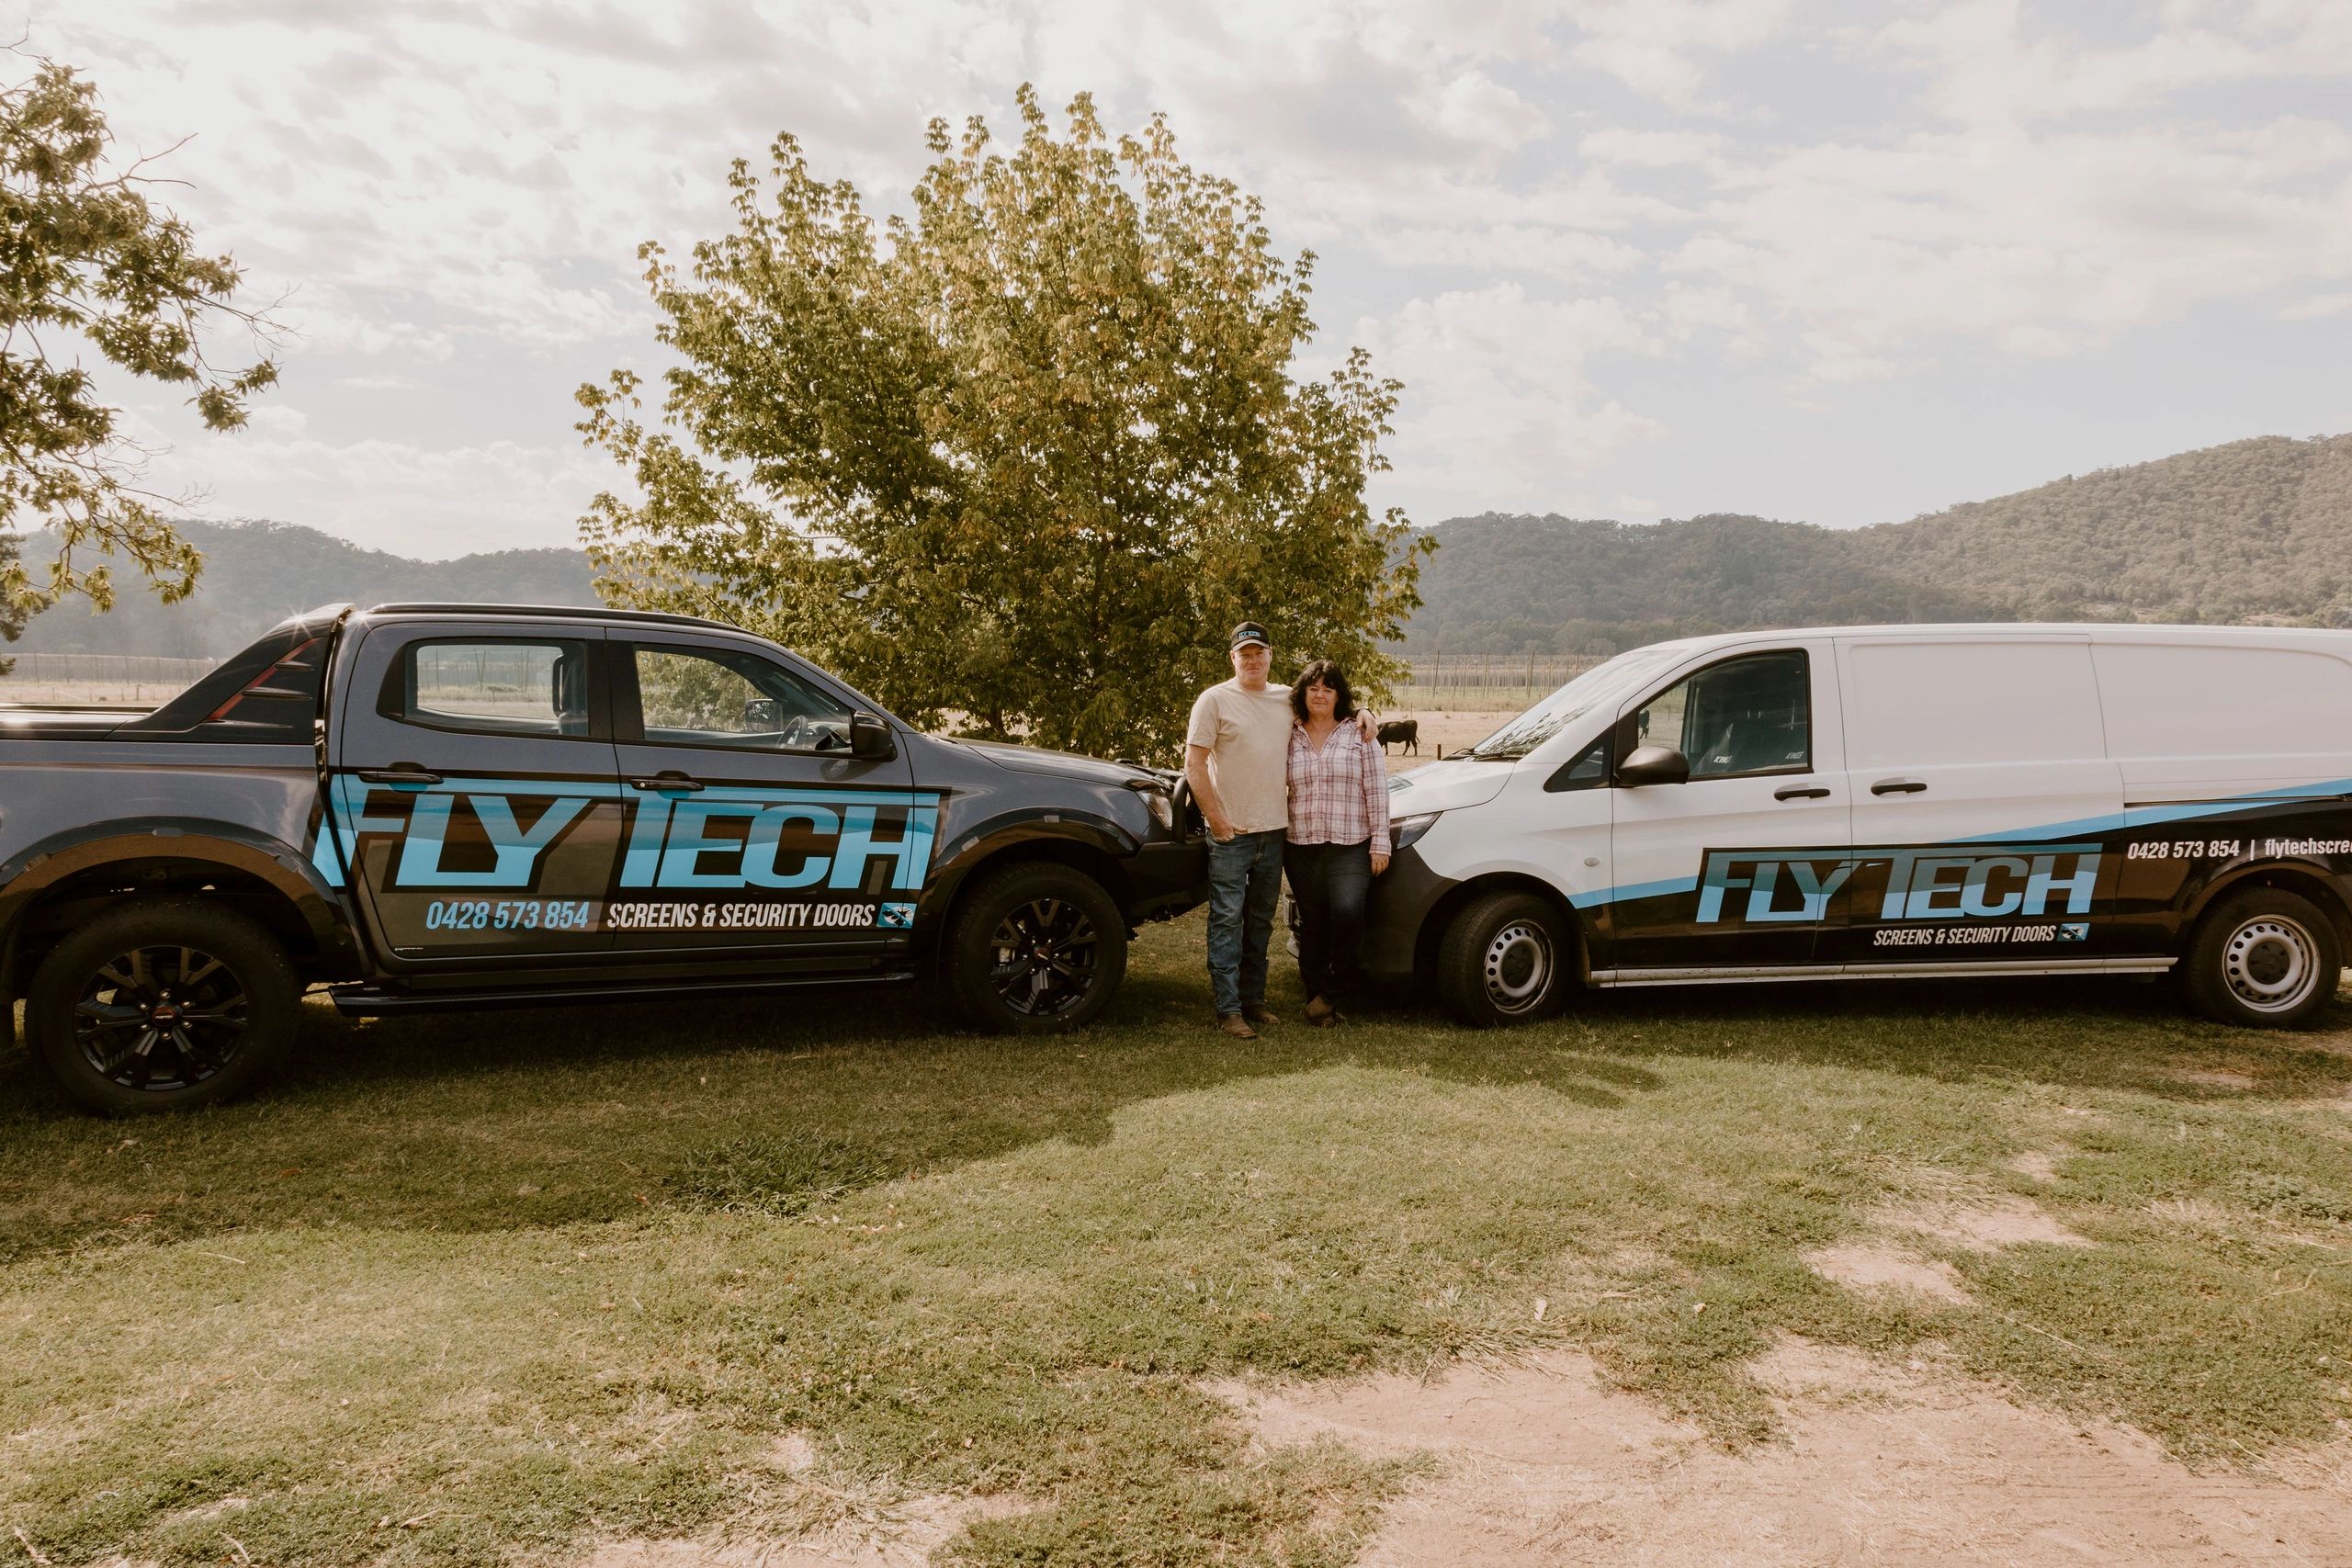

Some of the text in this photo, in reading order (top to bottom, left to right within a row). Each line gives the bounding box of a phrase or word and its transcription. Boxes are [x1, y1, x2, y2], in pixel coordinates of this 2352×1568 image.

[2127, 842, 2169, 860] 0428
[2172, 840, 2205, 859] 573
[2208, 840, 2240, 858] 854
[2265, 837, 2352, 859] flytechscre
[425, 901, 590, 930] 0428 573 854
[606, 903, 876, 928] SCREENS & SECURITY DOORS
[1873, 925, 2057, 946] SCREENS & SECURITY DOORS
